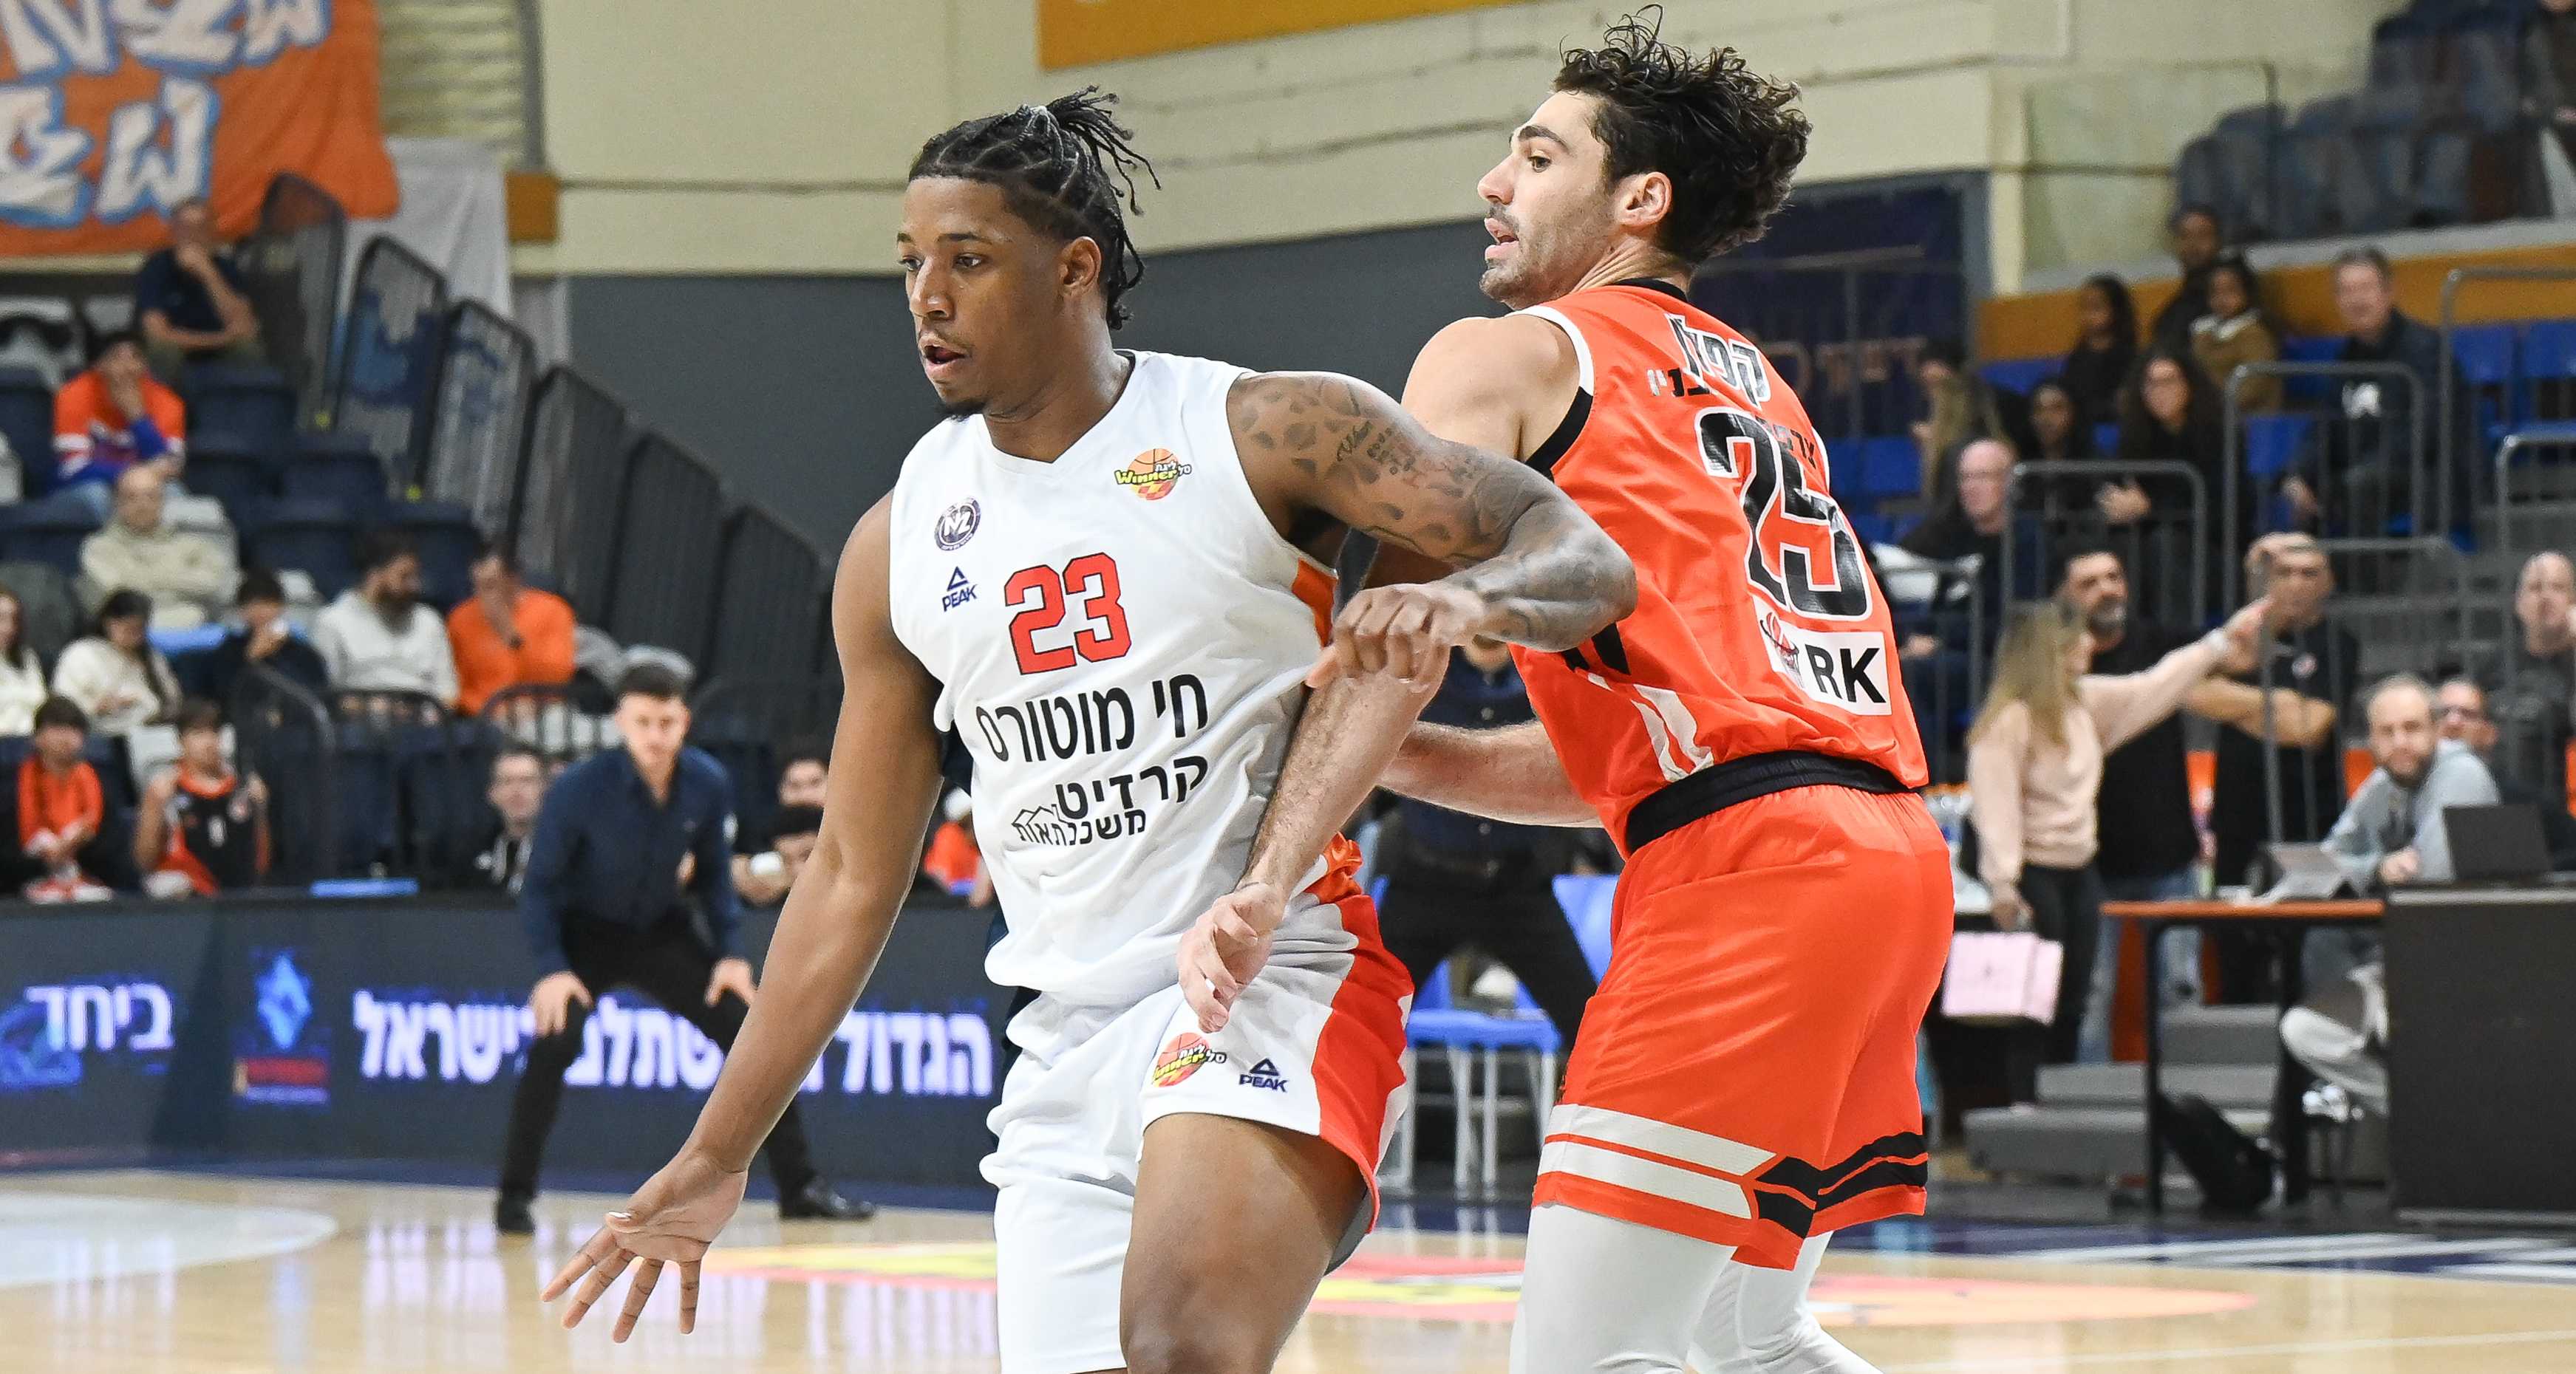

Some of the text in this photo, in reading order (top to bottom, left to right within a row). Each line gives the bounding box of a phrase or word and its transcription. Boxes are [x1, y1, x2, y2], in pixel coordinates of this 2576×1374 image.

[1114, 469, 1179, 485] Winner
[1177, 464, 1192, 476] סל
[944, 511, 972, 537] NZ
[1694, 406, 1873, 621] 25
[942, 584, 978, 612] PEAK
[1004, 552, 1131, 674] 23
[976, 674, 1208, 762] חי מוטורס
[1055, 756, 1208, 819] קרדיט
[1013, 810, 1146, 846] משכנתאות
[26, 982, 174, 1052] ביחד
[353, 990, 537, 1084] ישראל
[835, 1010, 992, 1096] הגדול
[1239, 1073, 1288, 1093] PEAK
